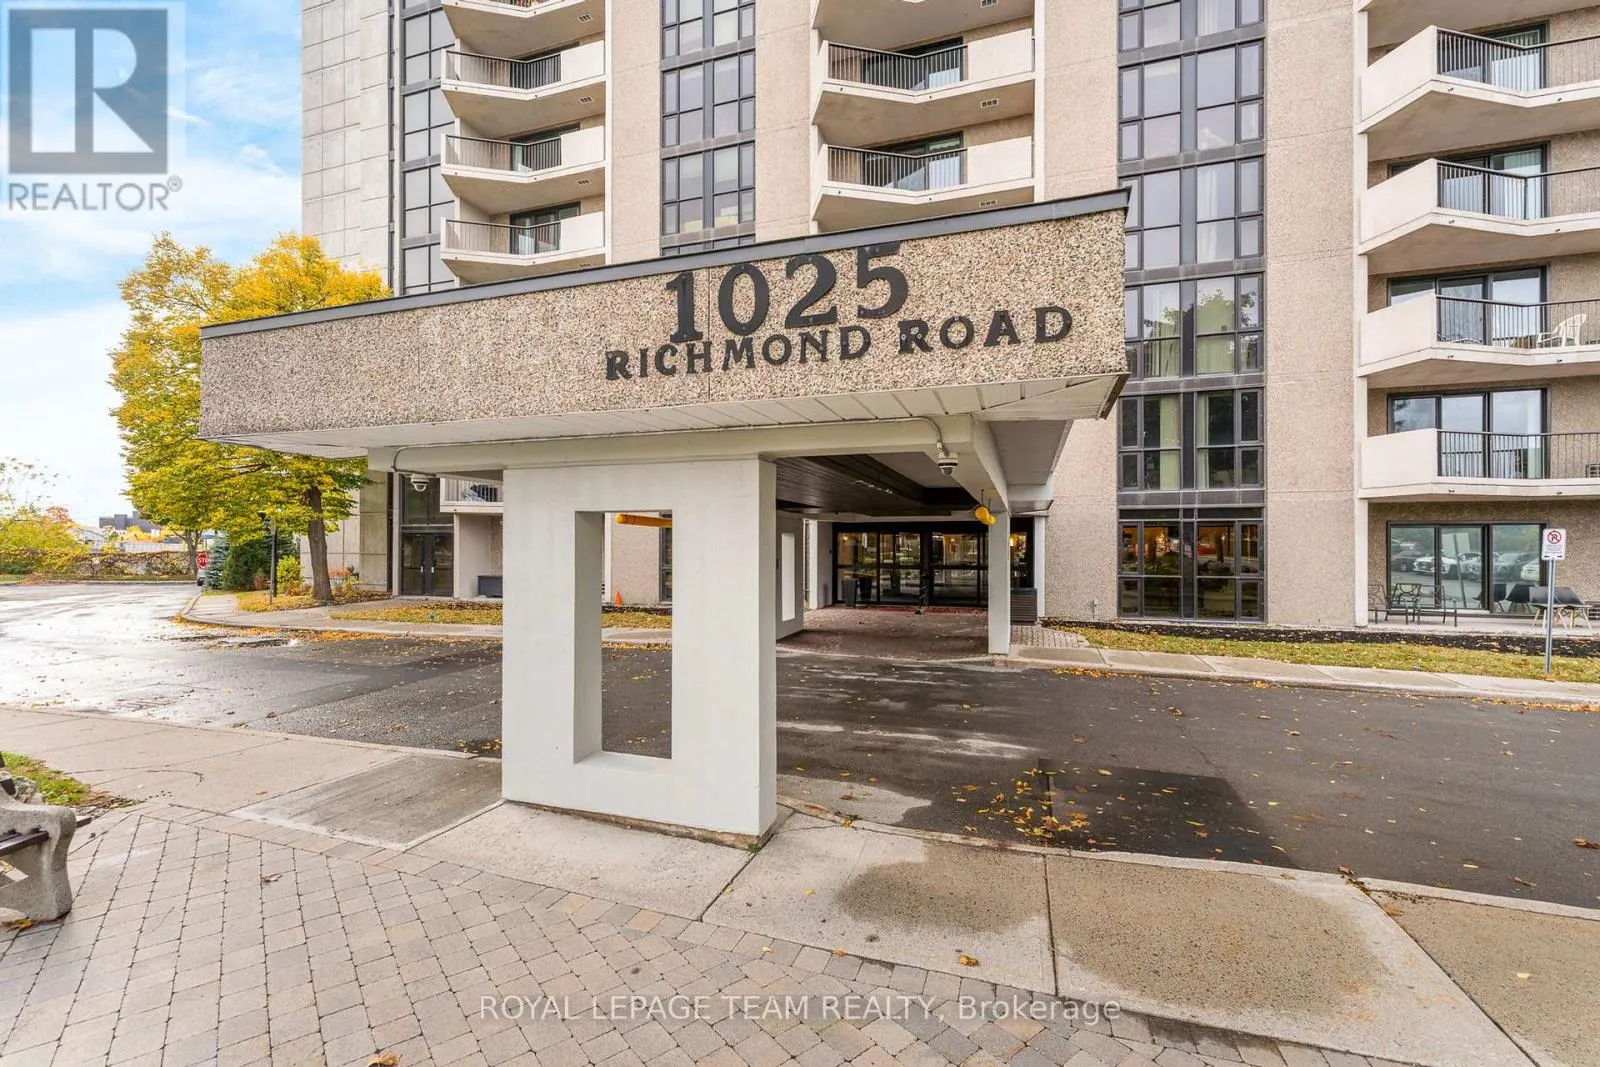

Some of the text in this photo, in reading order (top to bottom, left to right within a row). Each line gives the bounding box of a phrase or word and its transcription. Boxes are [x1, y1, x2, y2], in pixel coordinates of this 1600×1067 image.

[665, 240, 909, 344] 1025
[605, 305, 1073, 380] RICHMOND ROAD
